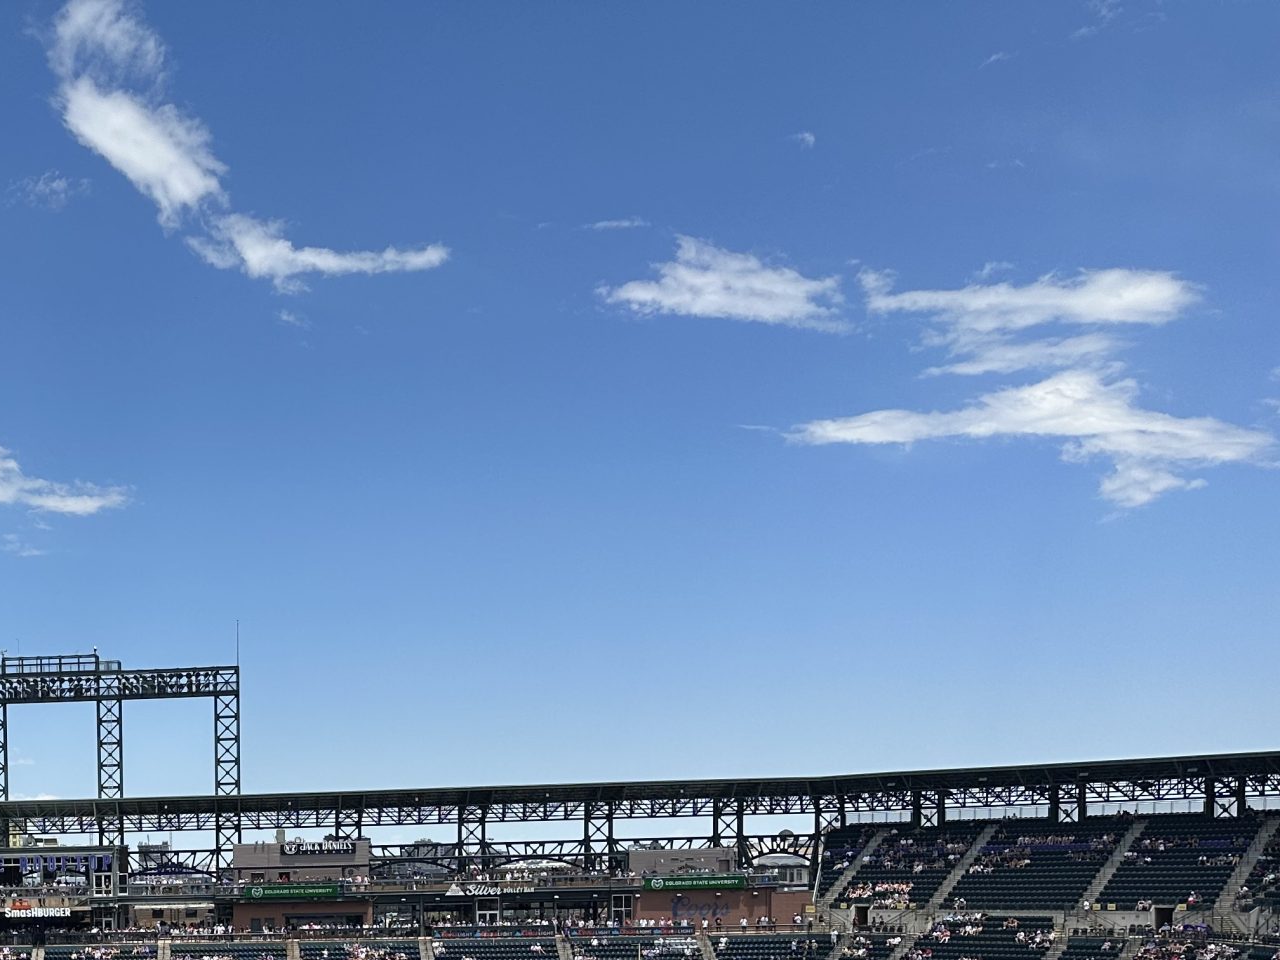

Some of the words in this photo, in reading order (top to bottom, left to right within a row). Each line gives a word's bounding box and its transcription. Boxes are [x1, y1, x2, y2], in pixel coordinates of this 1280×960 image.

[300, 841, 320, 851] JACK
[21, 854, 111, 873] ROOFTOP
[466, 884, 501, 896] Silver
[672, 895, 731, 919] Coors
